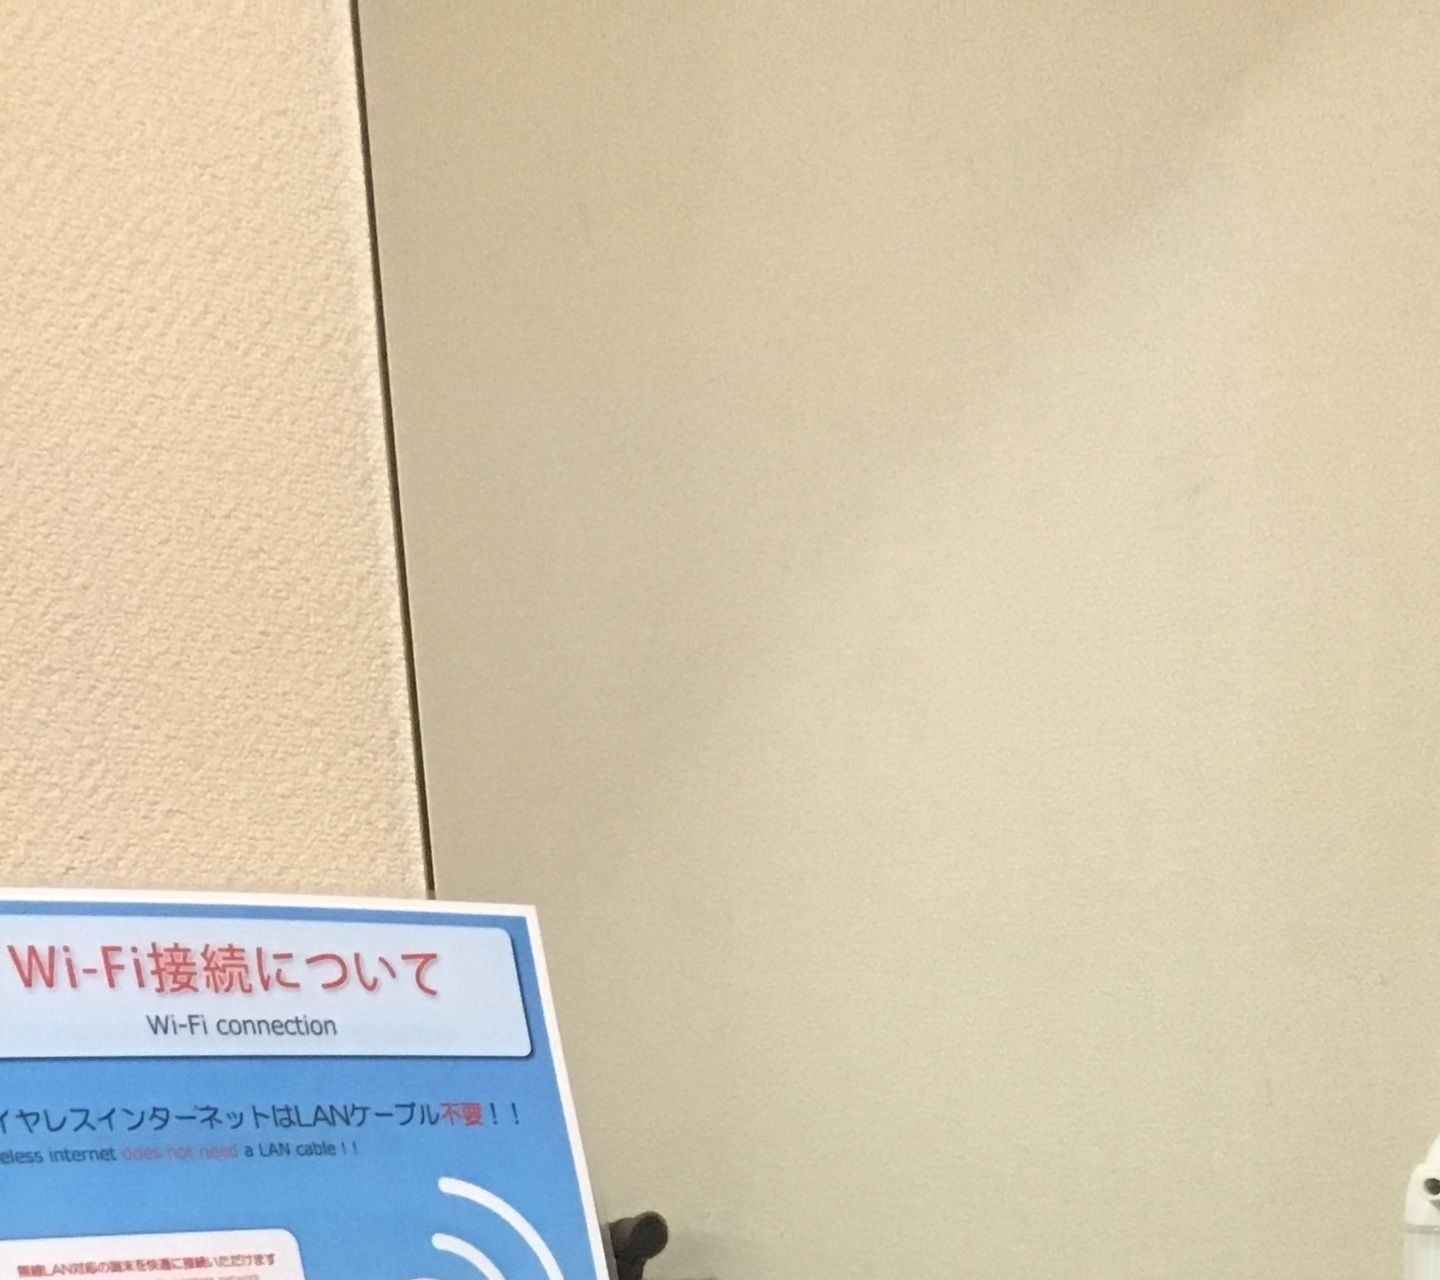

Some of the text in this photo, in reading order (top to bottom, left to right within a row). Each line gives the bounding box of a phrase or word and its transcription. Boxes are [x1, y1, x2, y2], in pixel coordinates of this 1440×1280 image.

[7, 943, 440, 997] Wi-Fi接続について
[146, 1014, 338, 1037] Wi-Fi connection
[50, 1146, 118, 1163] internet
[244, 1146, 254, 1158] a
[260, 1143, 291, 1158] LAN
